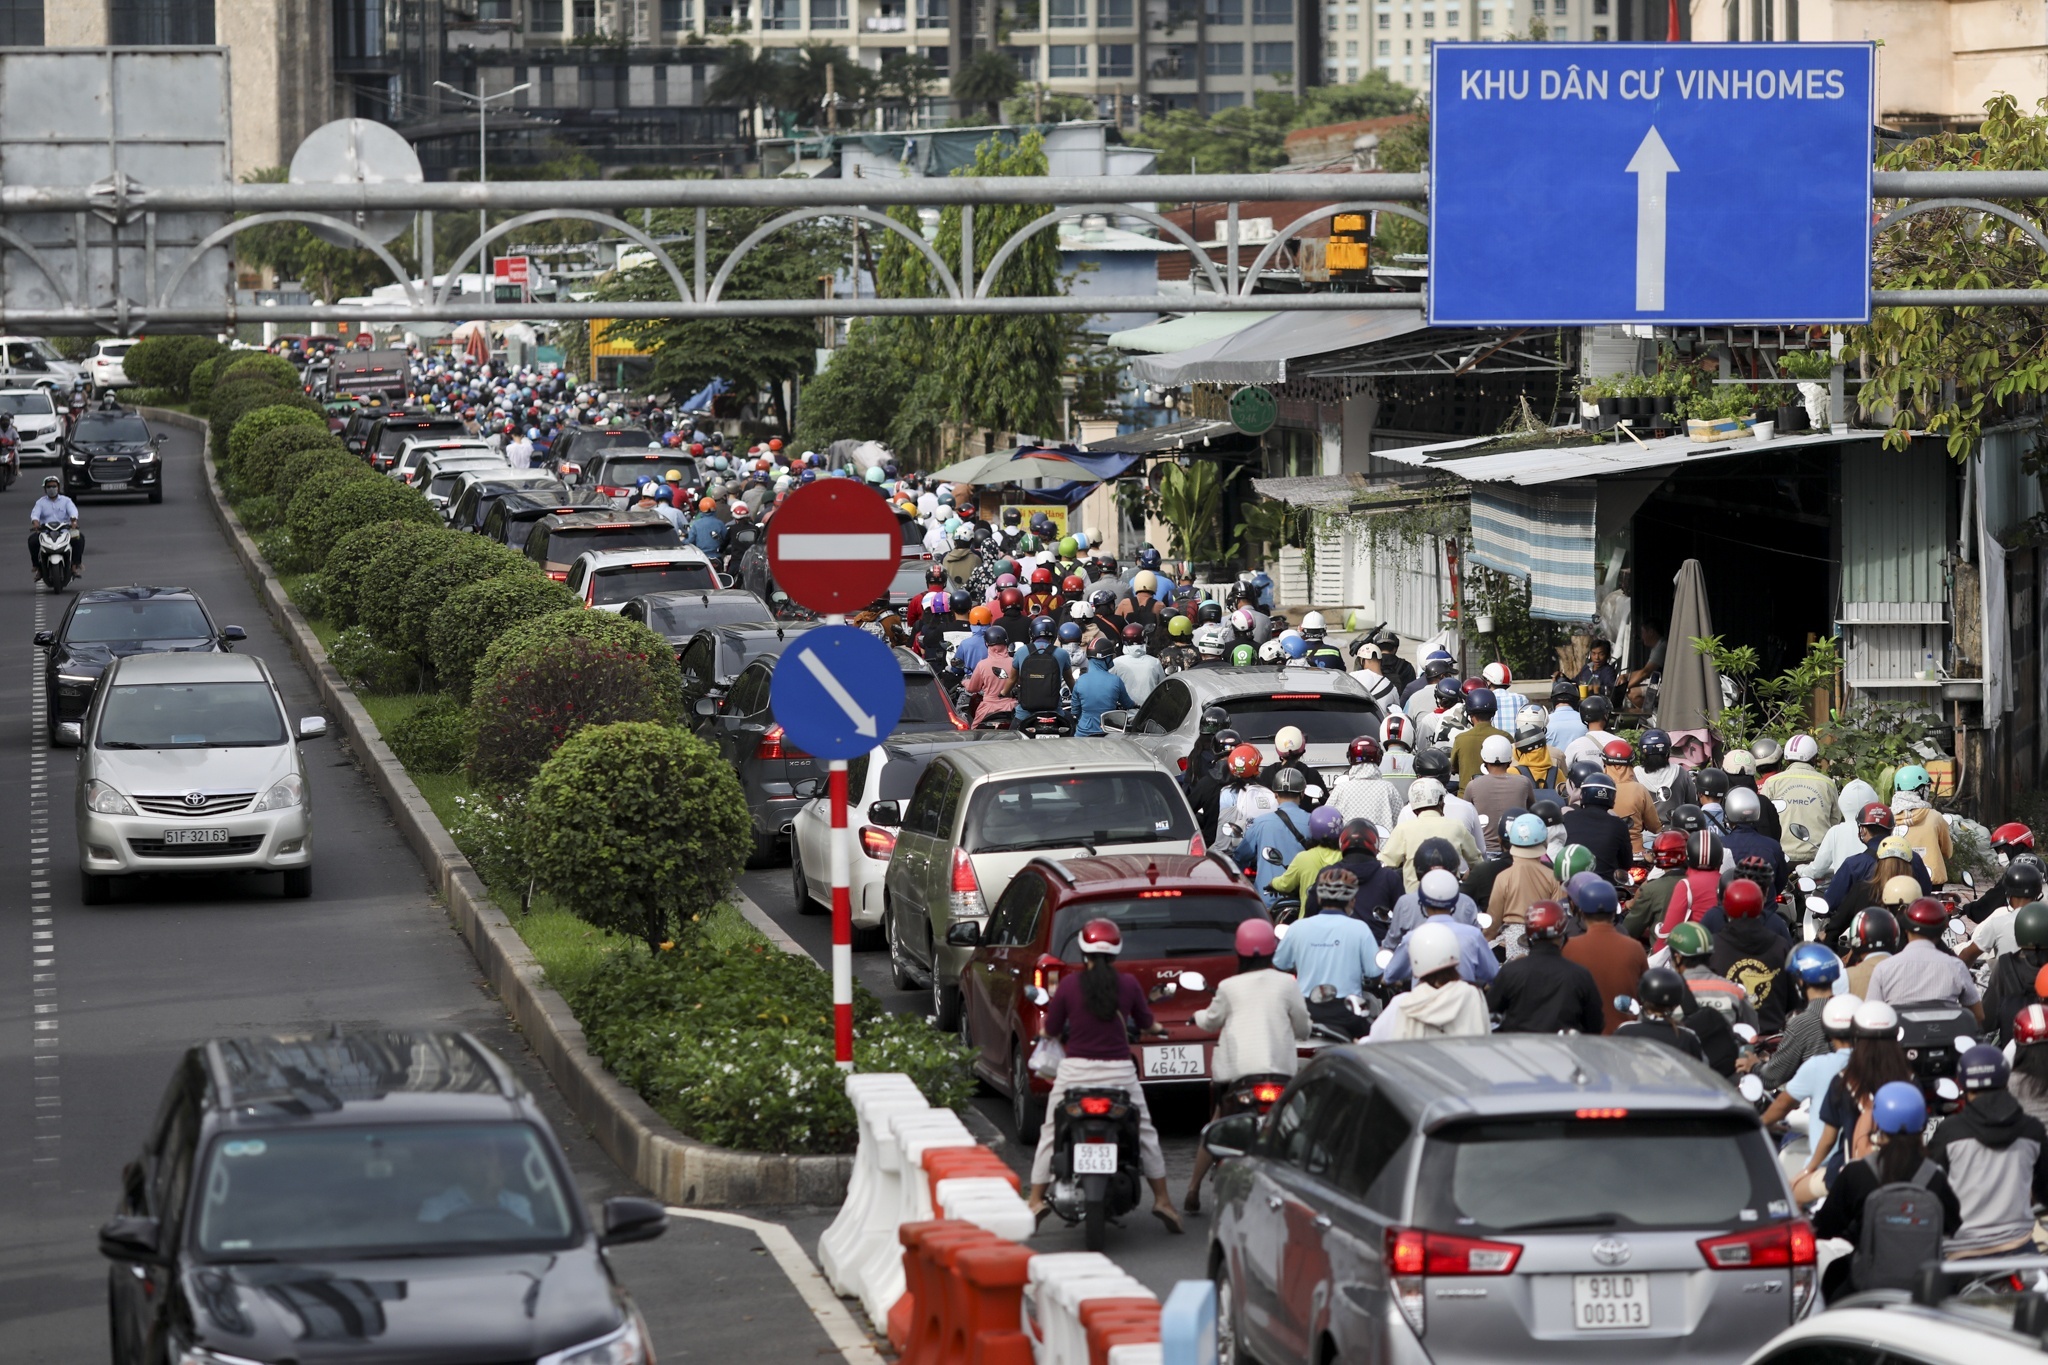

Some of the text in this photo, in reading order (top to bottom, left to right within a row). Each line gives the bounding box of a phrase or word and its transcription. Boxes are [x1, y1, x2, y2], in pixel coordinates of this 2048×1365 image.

[1460, 64, 1845, 100] KHU DÂN CƯ VINHOMES
[166, 830, 226, 843] 51F-321.63
[1160, 1046, 1186, 1060] 51K
[1151, 1060, 1198, 1074] 464.72
[1590, 1277, 1634, 1298] 93LD
[1584, 1303, 1642, 1323] 003.13
